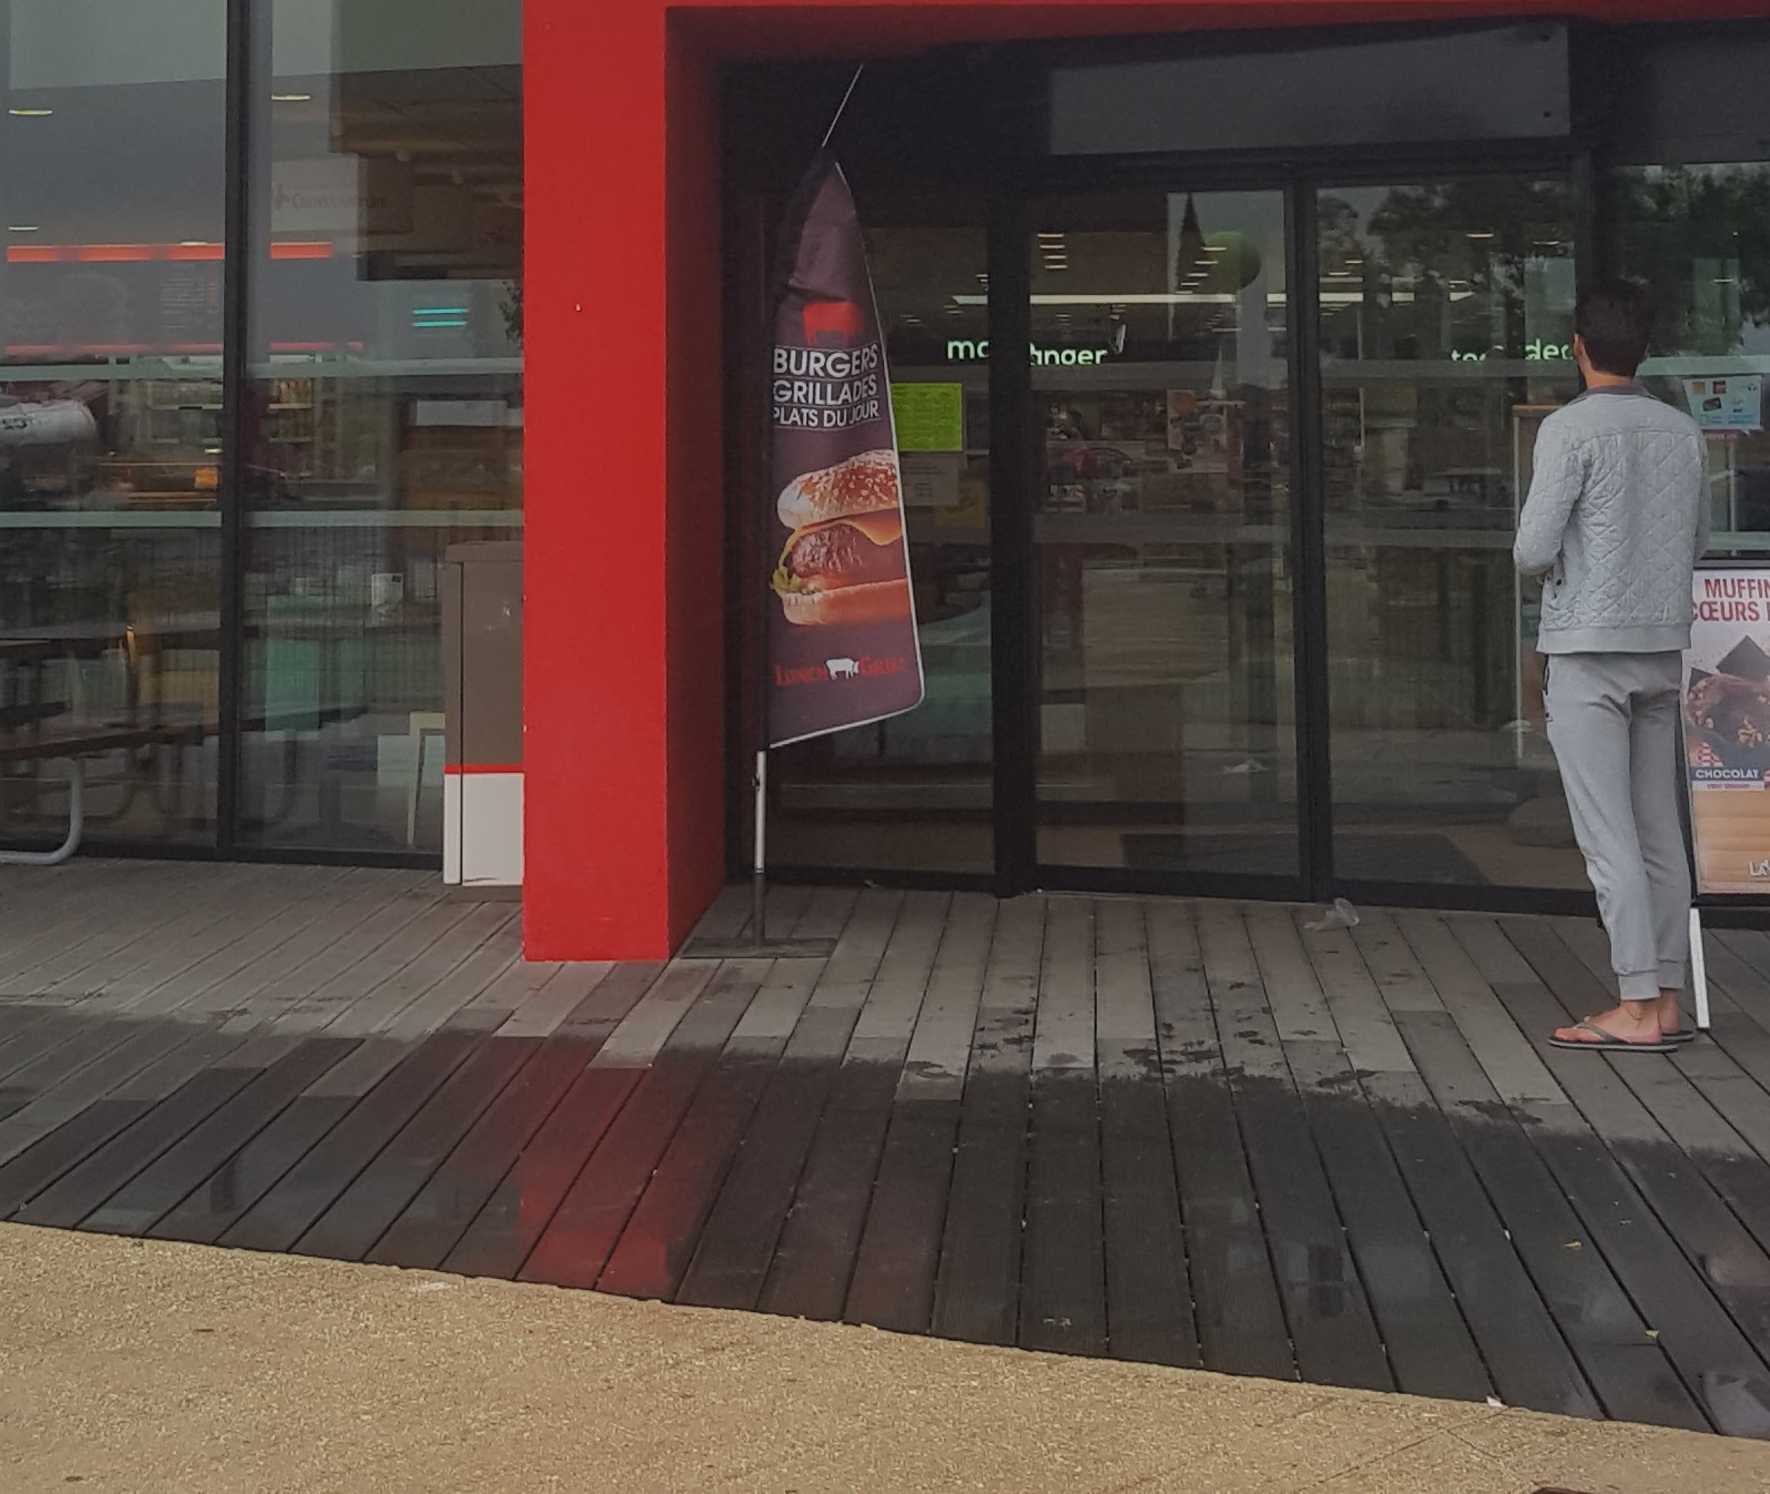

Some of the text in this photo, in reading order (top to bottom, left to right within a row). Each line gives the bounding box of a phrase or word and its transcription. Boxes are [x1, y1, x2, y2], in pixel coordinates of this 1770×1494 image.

[773, 344, 878, 378] BURGERS
[773, 374, 877, 405] GRILLADES
[824, 409, 847, 427] DU
[849, 400, 880, 424] JOUR
[1695, 768, 1759, 779] CHOCOLAT
